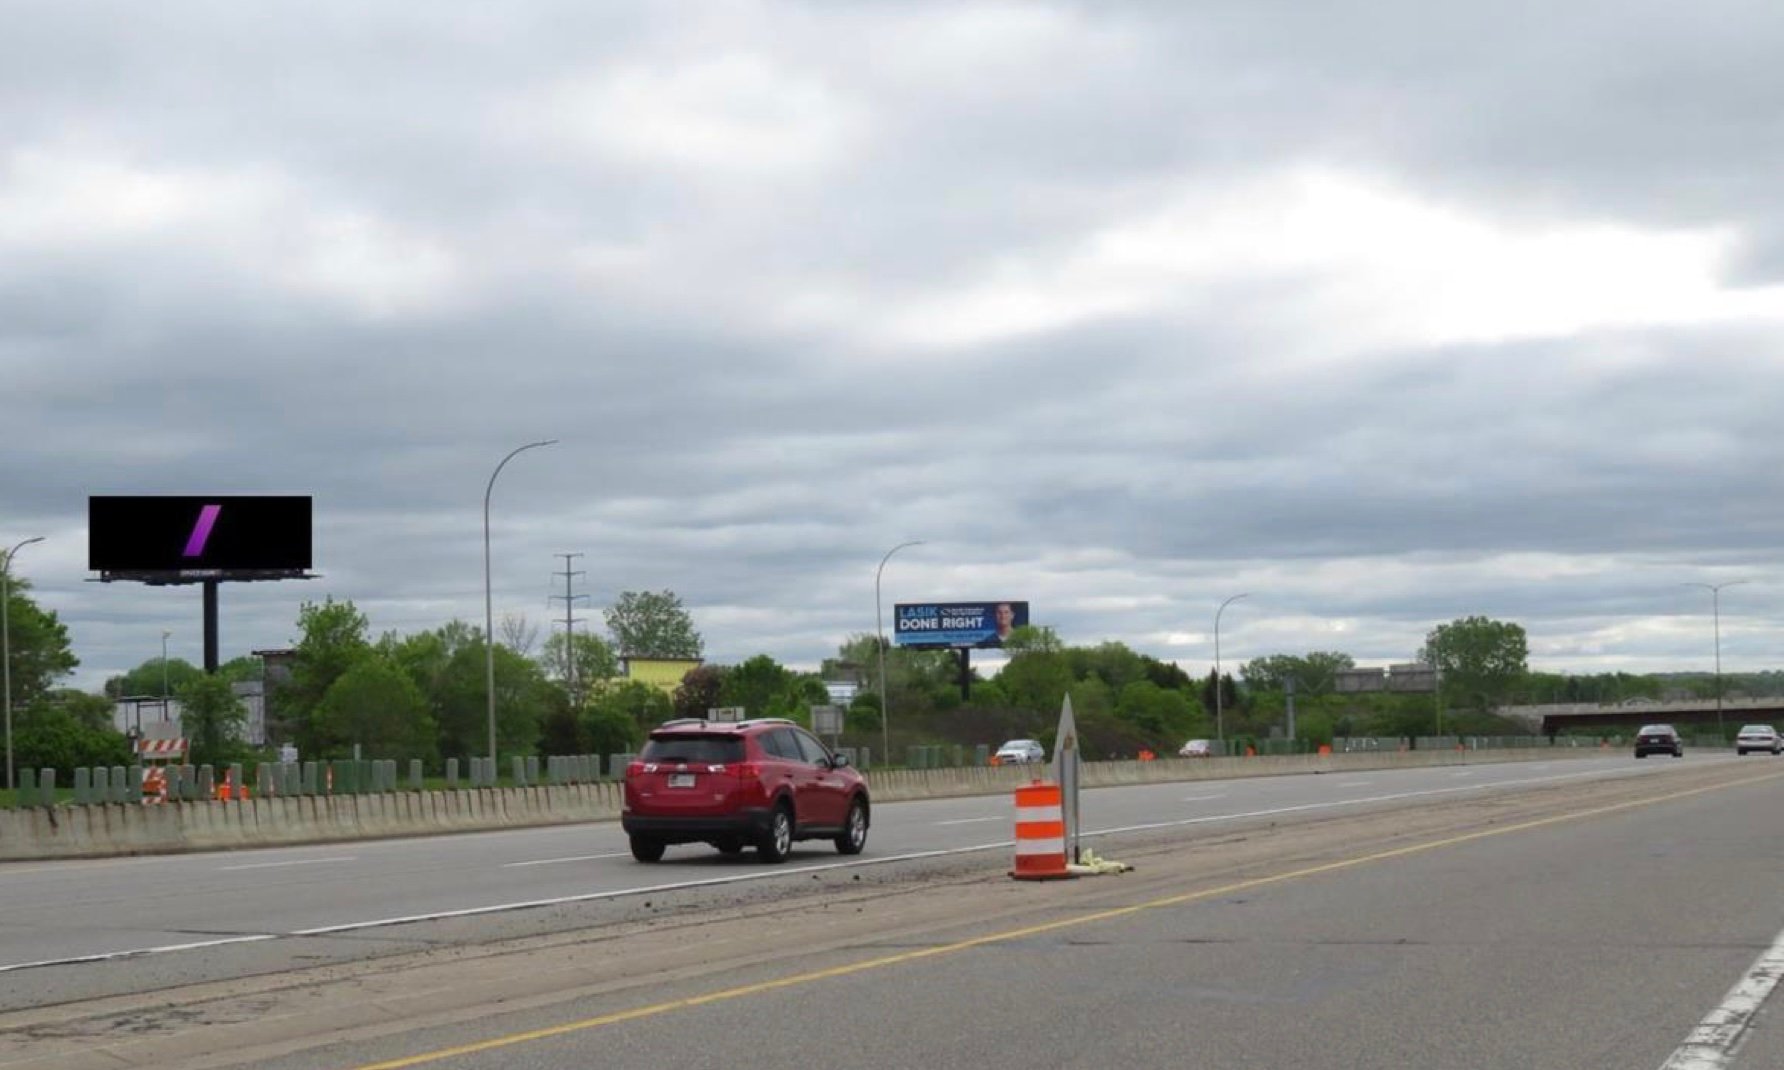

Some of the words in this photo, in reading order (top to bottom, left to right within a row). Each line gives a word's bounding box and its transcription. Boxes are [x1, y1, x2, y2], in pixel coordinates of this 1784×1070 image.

[899, 606, 938, 618] LASIK
[899, 618, 939, 630] DONE
[942, 617, 985, 629] RIGHT
